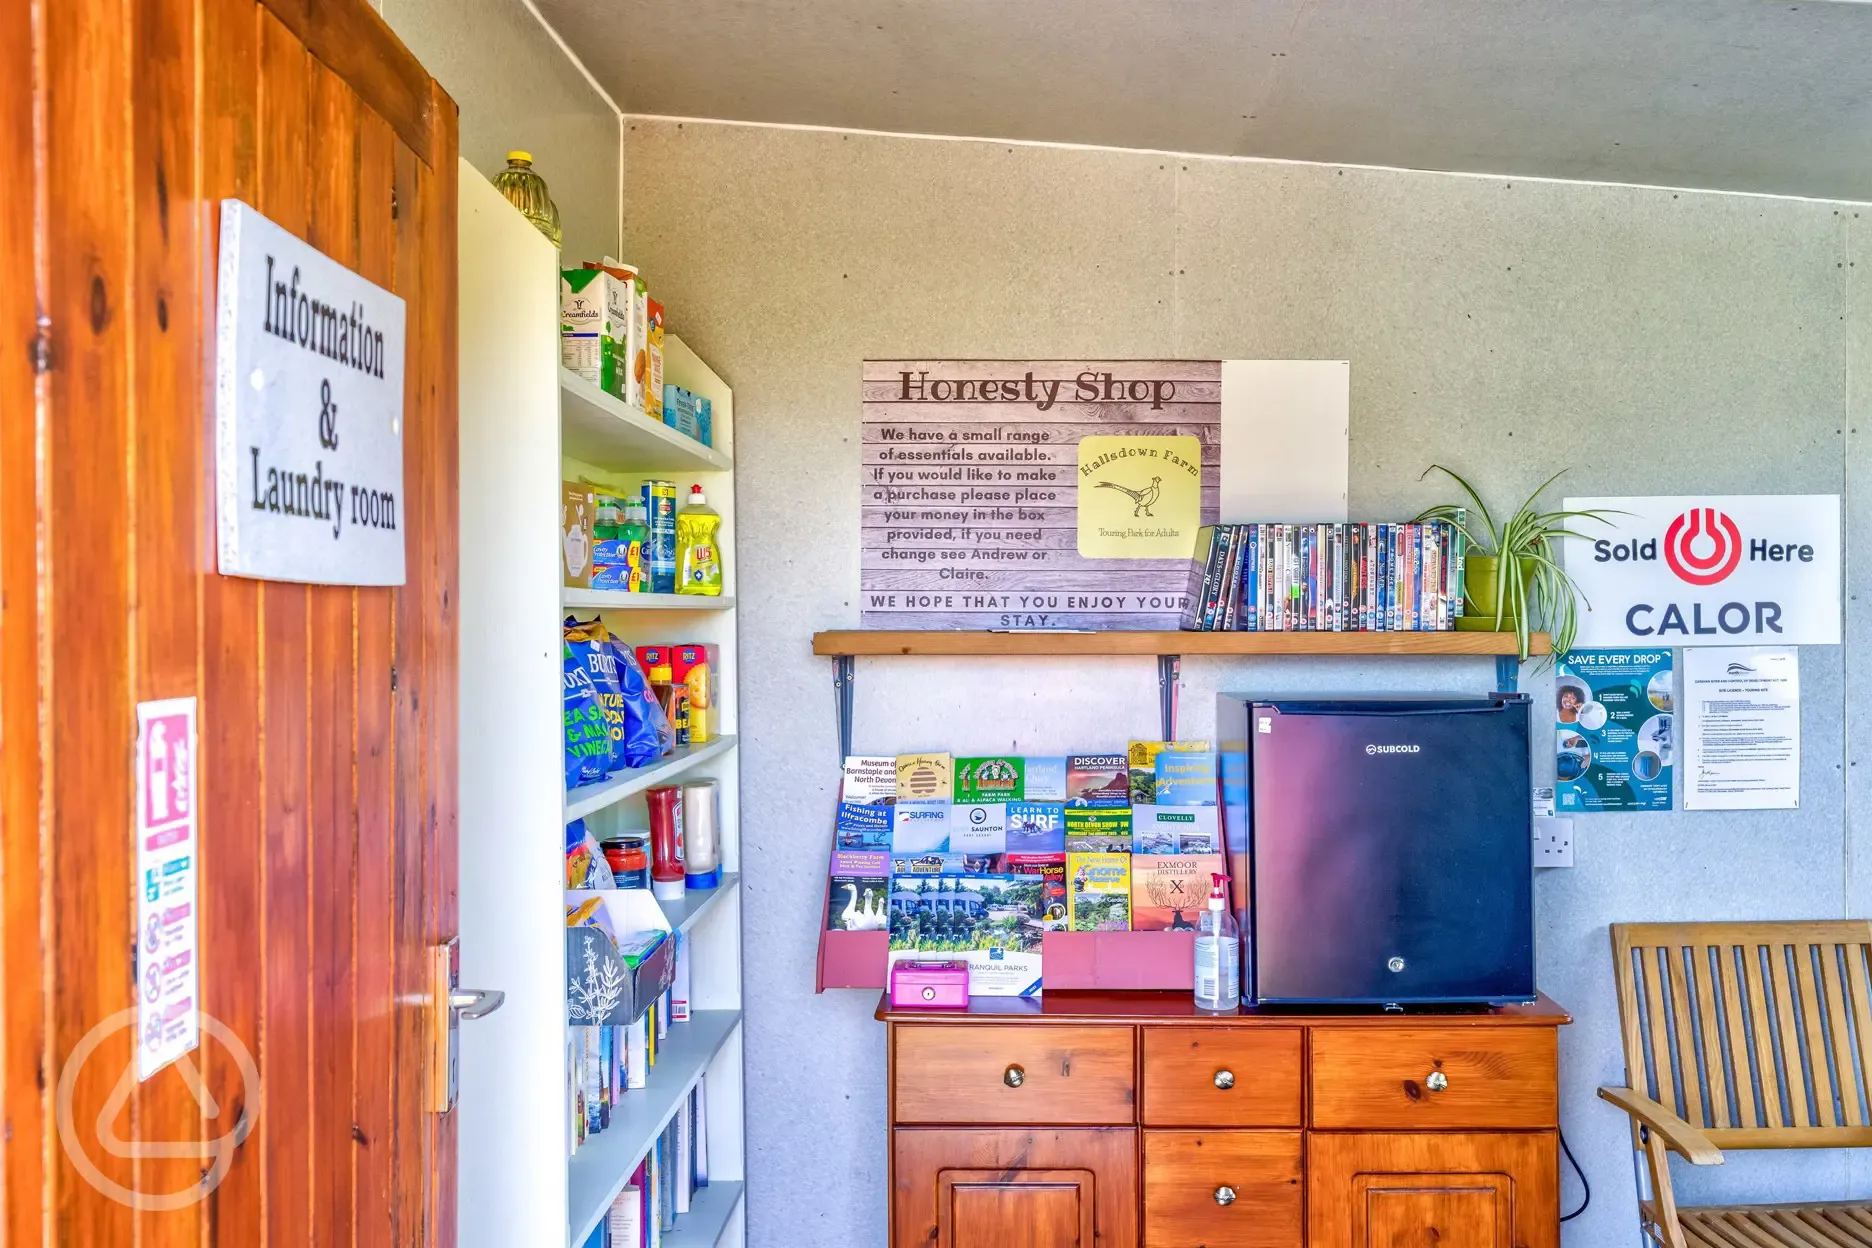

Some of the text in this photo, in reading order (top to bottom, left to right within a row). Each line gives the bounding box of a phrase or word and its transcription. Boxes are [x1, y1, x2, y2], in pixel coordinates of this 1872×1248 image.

[264, 253, 385, 380] Information
[562, 310, 598, 318] Creamfields
[898, 371, 1176, 411] Honesty Shop
[318, 380, 339, 451] &
[881, 428, 1050, 444] We have a small range
[879, 448, 1051, 460] of essentials available.
[1080, 447, 1200, 477] Hallsdown Farm
[874, 468, 1056, 483] If you would like to make
[251, 447, 396, 540] Laundry room
[874, 488, 1056, 503] a purchase please place
[884, 508, 1045, 523] your money in the box
[887, 529, 1042, 543] provided, if you need
[1098, 528, 1180, 539] Touring Park for Adults
[630, 546, 639, 557] £1
[882, 549, 936, 562] change
[940, 552, 966, 560] see
[971, 549, 1028, 560] Andrew
[1594, 538, 1814, 562] Sold Here
[631, 572, 640, 582] £1
[939, 568, 989, 580] Claire.
[1212, 572, 1220, 595] GLORY
[870, 596, 1184, 609] WE HOPE THAT YOU ENJOY YOUR
[1000, 615, 1056, 626] STAY.
[1625, 601, 1783, 636] CALOR
[646, 652, 658, 660] RITZ
[683, 652, 695, 660] RITZ
[1568, 654, 1662, 665] SAVE EVERY DROP
[564, 707, 584, 726] EA
[1610, 711, 1616, 719] 2
[567, 728, 582, 743] &
[1376, 744, 1420, 754] SUBCOLD
[1074, 757, 1125, 765] DISCOVER
[846, 768, 882, 776] Barnstaple
[1165, 764, 1210, 775] Inspiring
[845, 804, 875, 817] Fishing
[841, 811, 888, 825] Ilfracombe
[1010, 814, 1059, 829] SURF
